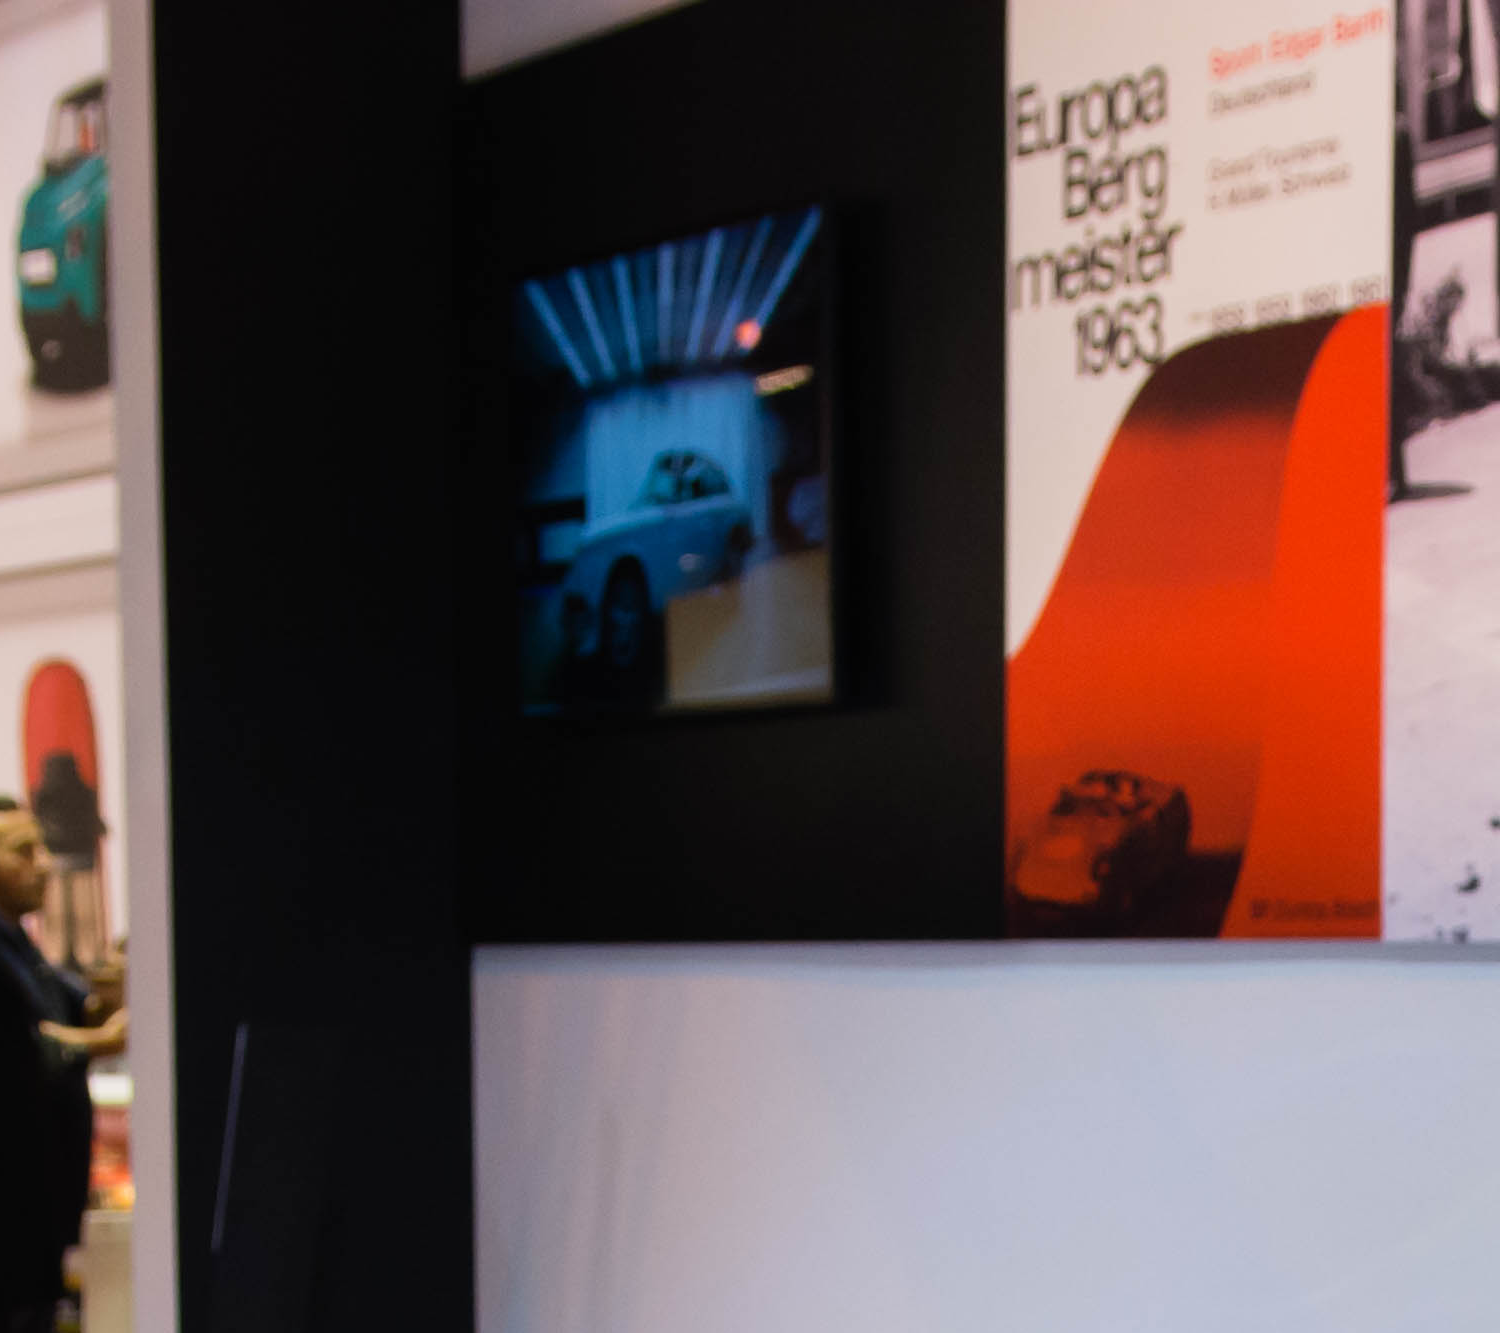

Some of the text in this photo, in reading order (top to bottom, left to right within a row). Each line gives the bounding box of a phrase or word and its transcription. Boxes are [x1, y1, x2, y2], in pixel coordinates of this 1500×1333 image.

[1015, 64, 1167, 157] Europa
[1063, 146, 1167, 221] Berg
[1014, 221, 1184, 309] meister
[1077, 296, 1165, 375] 1963
